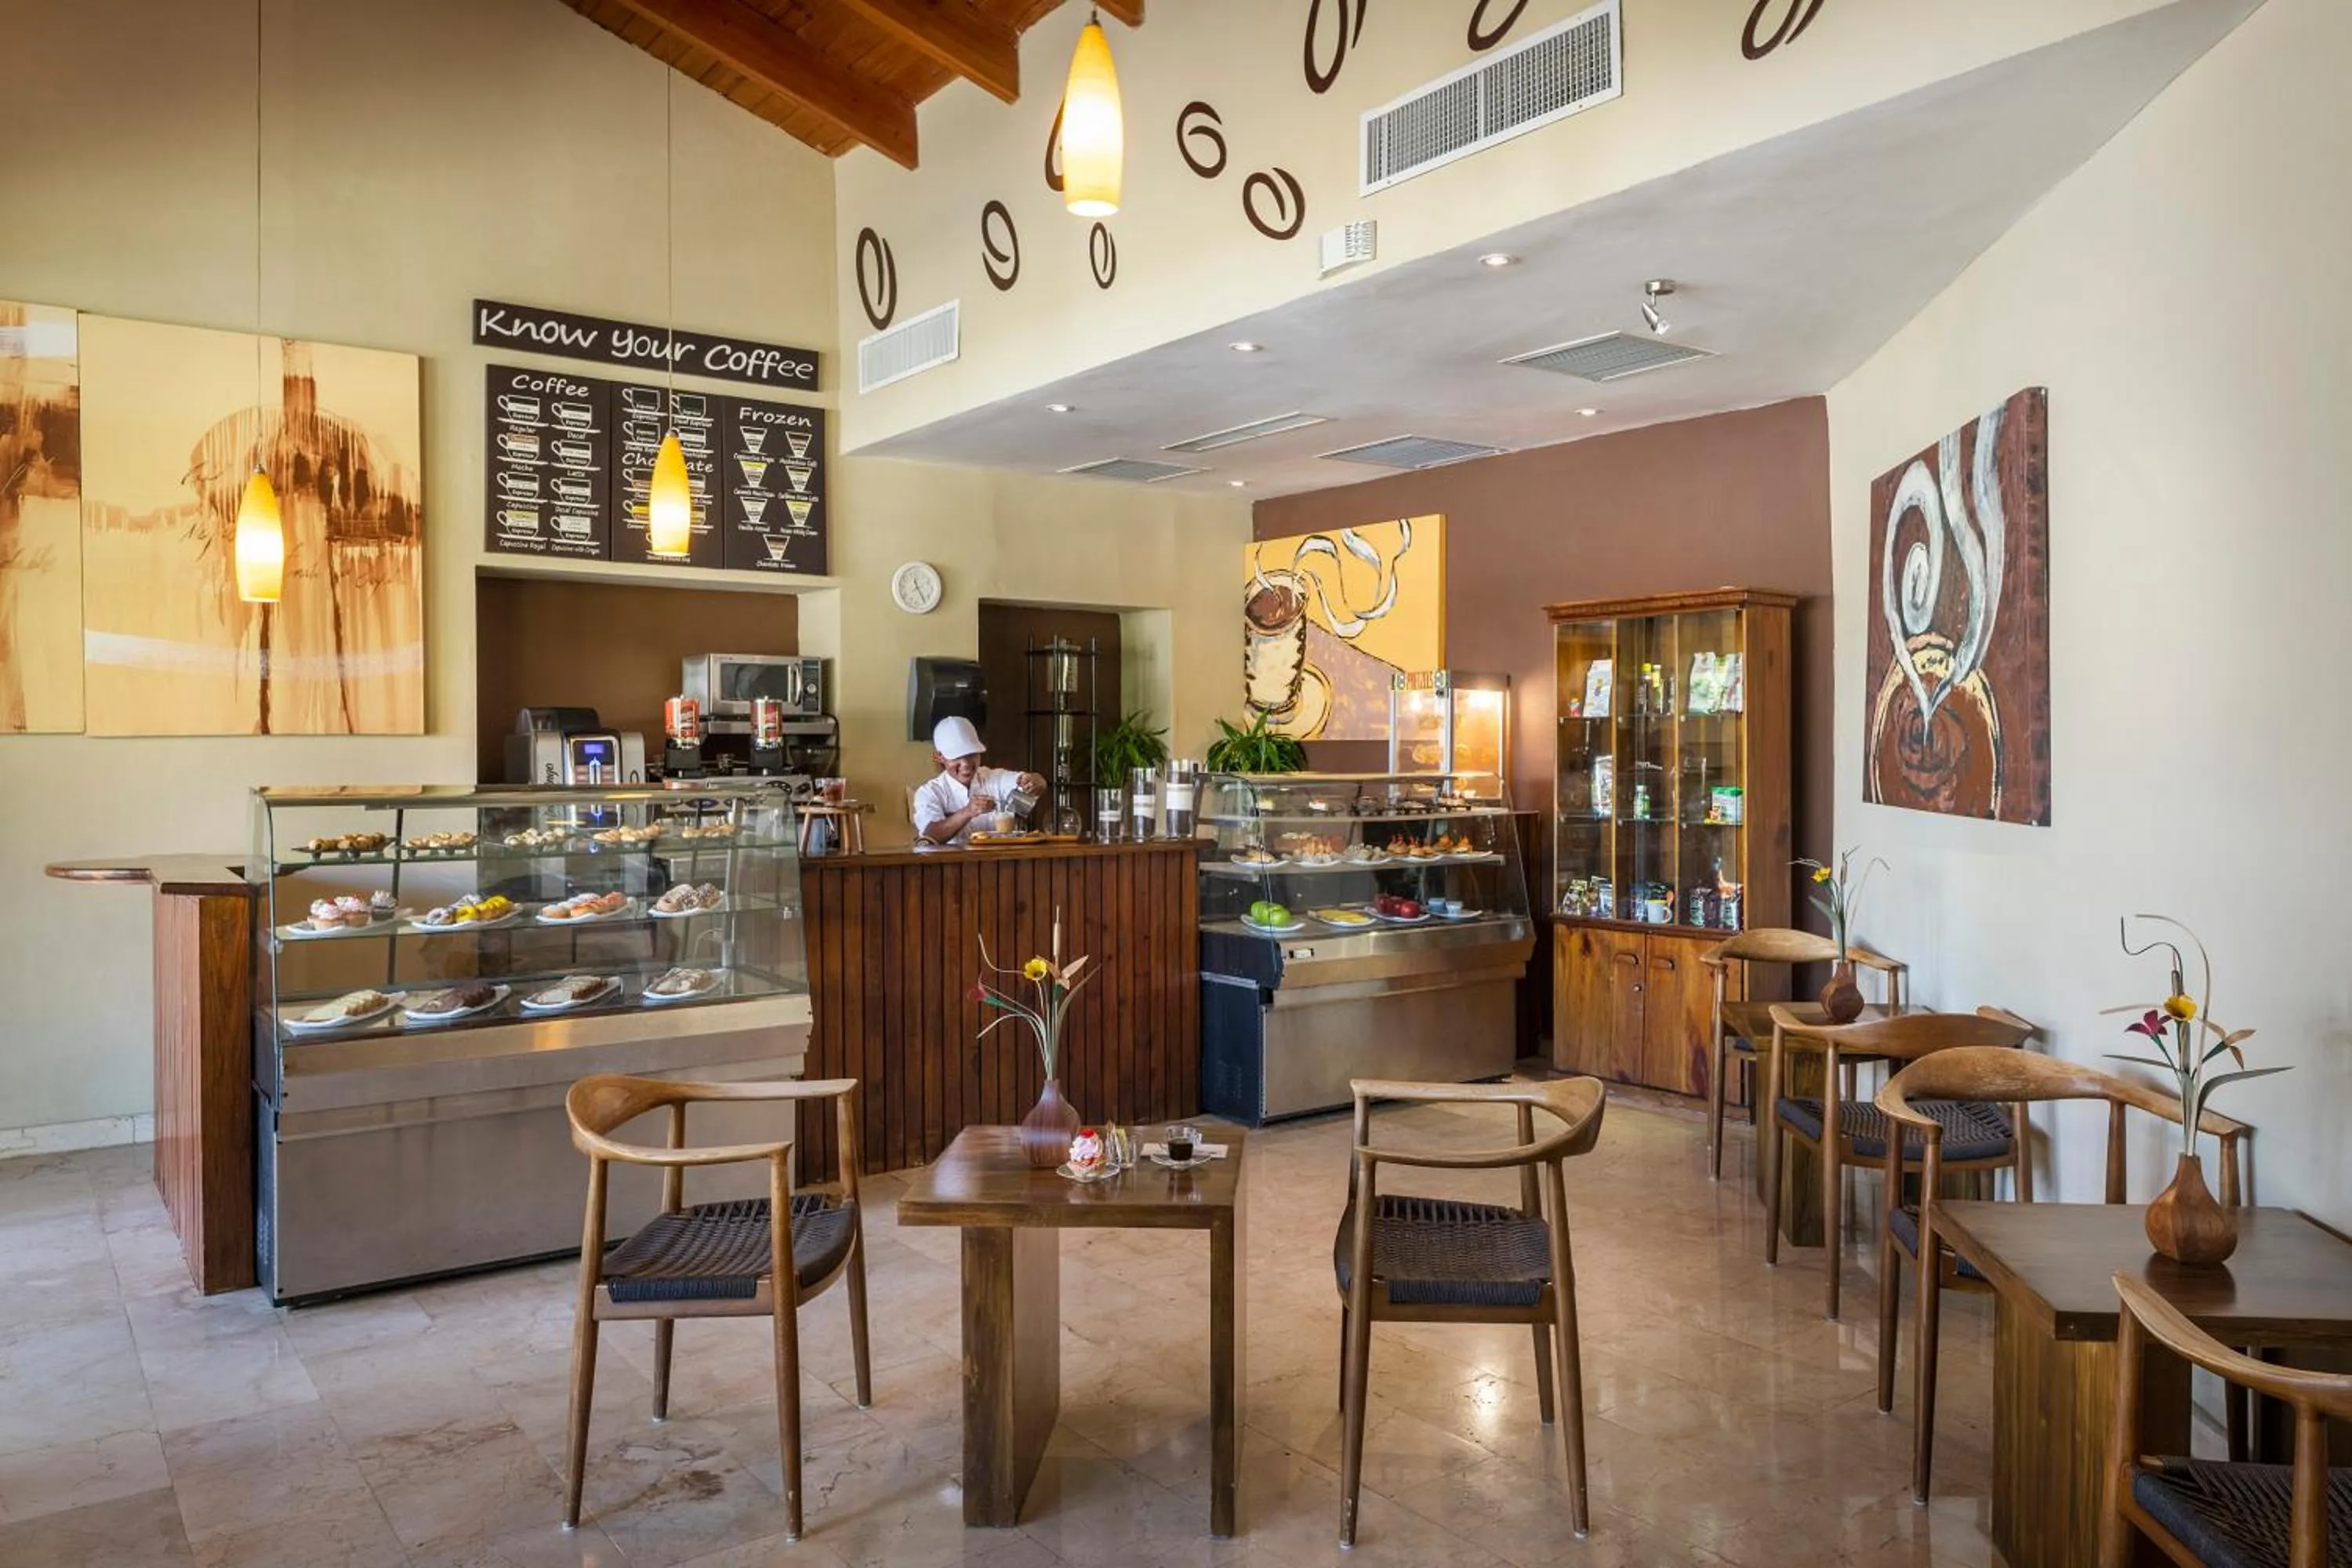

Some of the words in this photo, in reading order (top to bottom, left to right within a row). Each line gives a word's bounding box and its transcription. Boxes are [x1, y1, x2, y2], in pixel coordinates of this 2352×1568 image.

[480, 308, 598, 348] Know
[611, 328, 696, 361] your
[705, 345, 814, 380] Coffee
[511, 374, 590, 397] Coffee
[739, 406, 812, 427] Frozen
[622, 452, 714, 473] Choate
